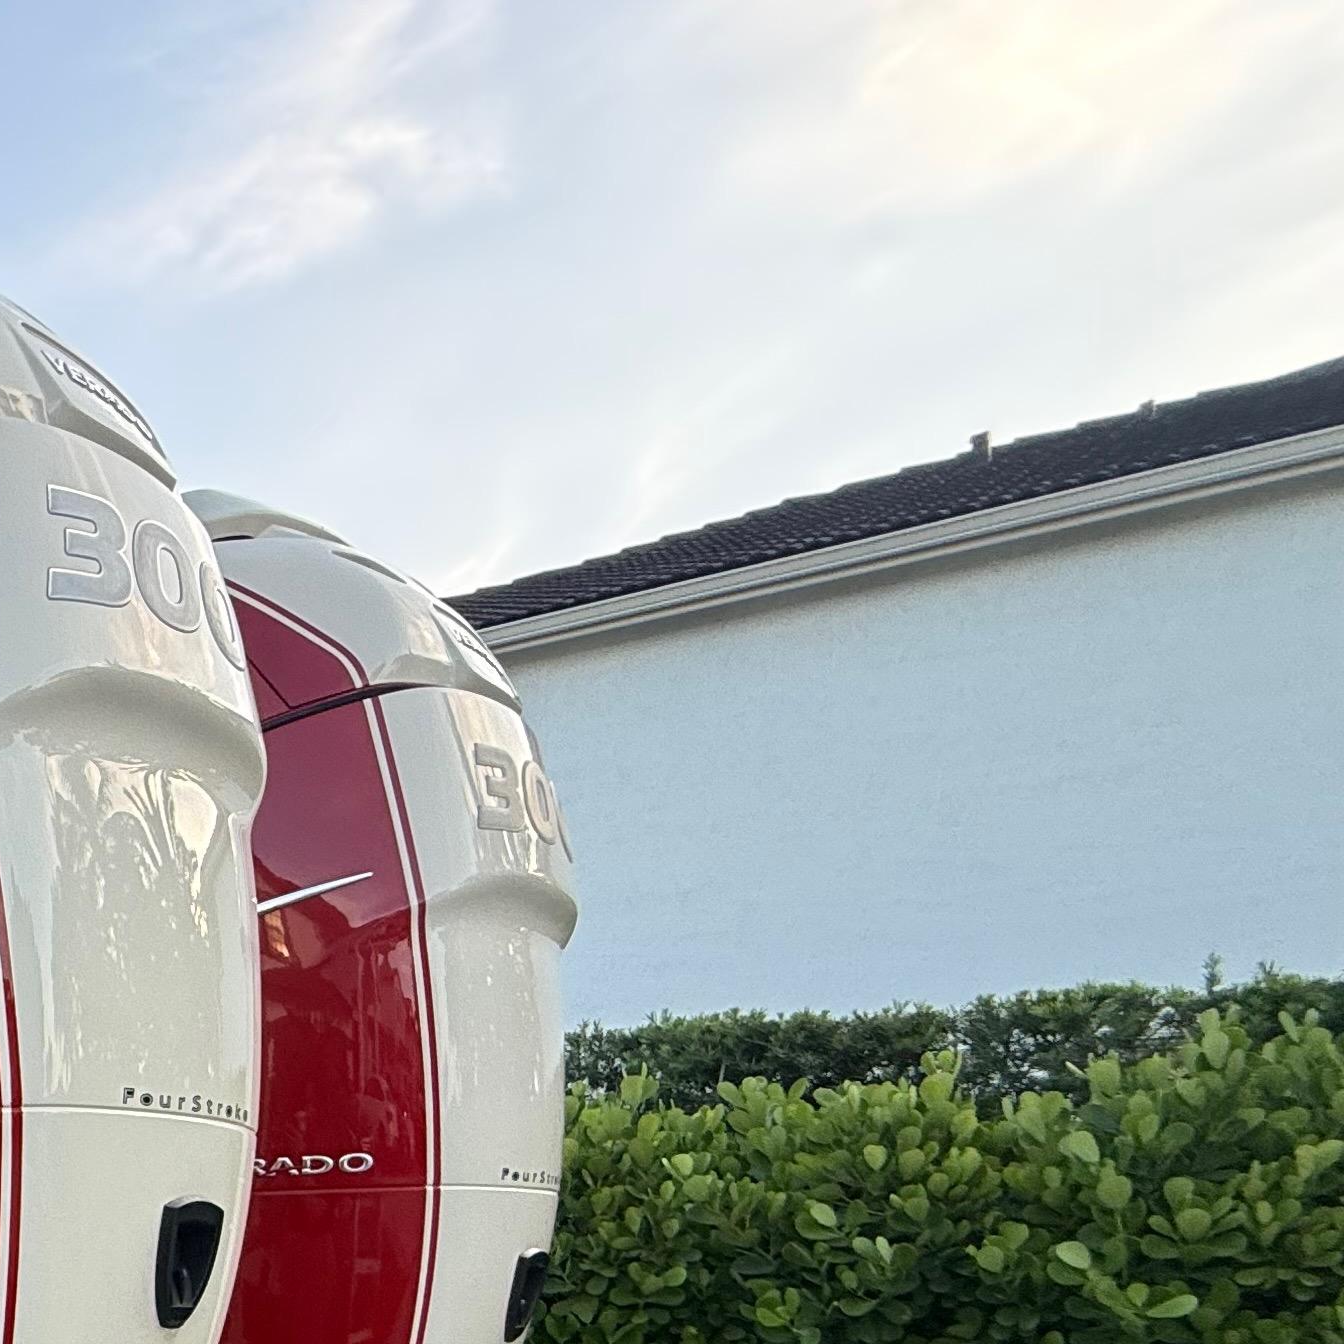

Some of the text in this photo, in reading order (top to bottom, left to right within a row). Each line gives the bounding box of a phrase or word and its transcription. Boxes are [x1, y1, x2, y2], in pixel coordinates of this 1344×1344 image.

[46, 483, 245, 672] 300
[474, 742, 573, 864] 30
[122, 1086, 249, 1123] FourStroke
[253, 1152, 374, 1177] RADO
